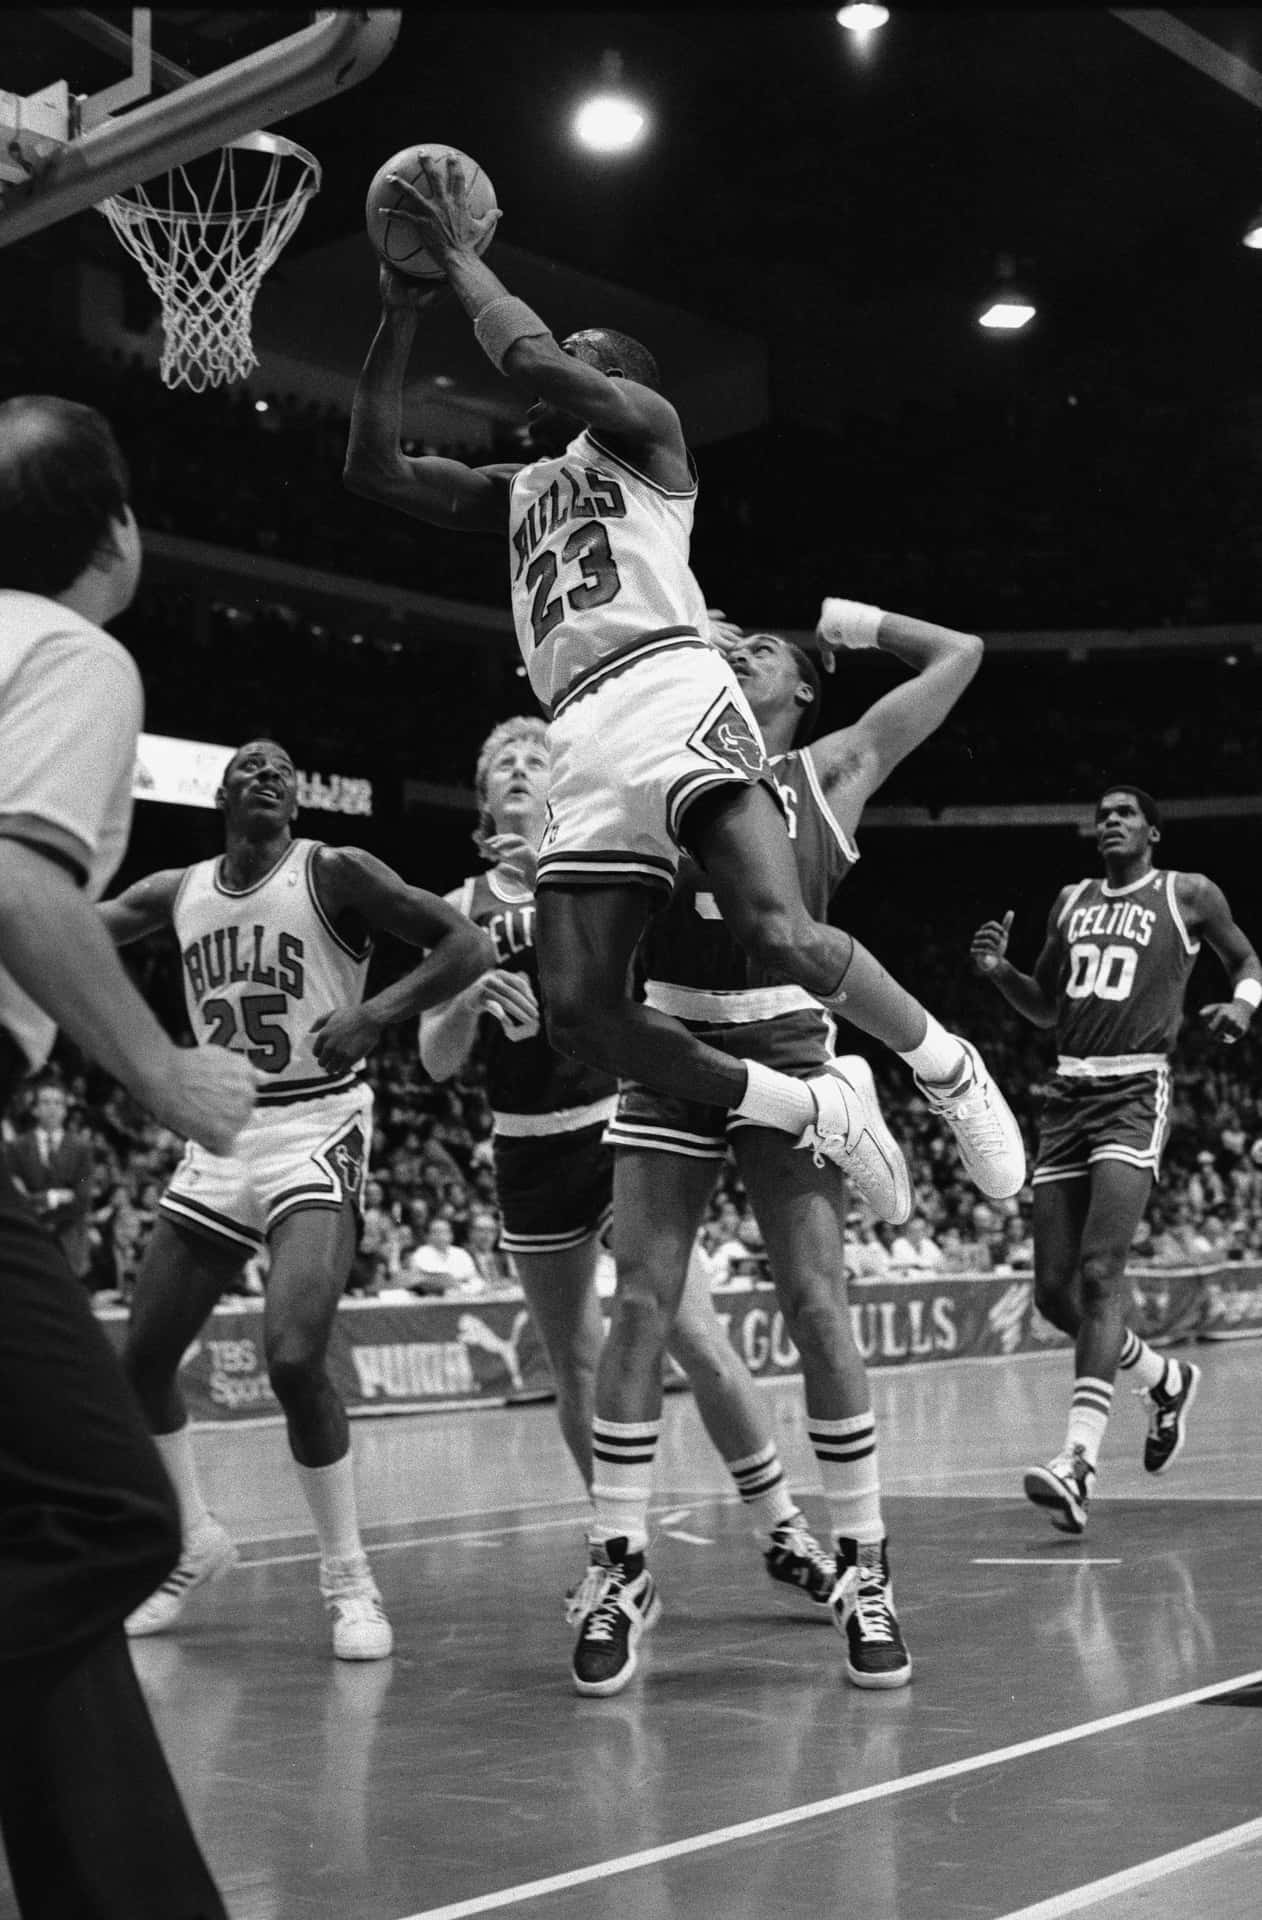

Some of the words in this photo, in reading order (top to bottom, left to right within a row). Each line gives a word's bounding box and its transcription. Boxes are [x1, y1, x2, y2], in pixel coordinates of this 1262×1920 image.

[512, 467, 627, 583] BULLS
[525, 519, 622, 649] 23
[1068, 902, 1156, 946] CELTICS
[183, 925, 304, 1006] BULLS
[1065, 943, 1138, 1001] 00
[202, 994, 292, 1074] 25
[850, 1296, 957, 1359] ULLS
